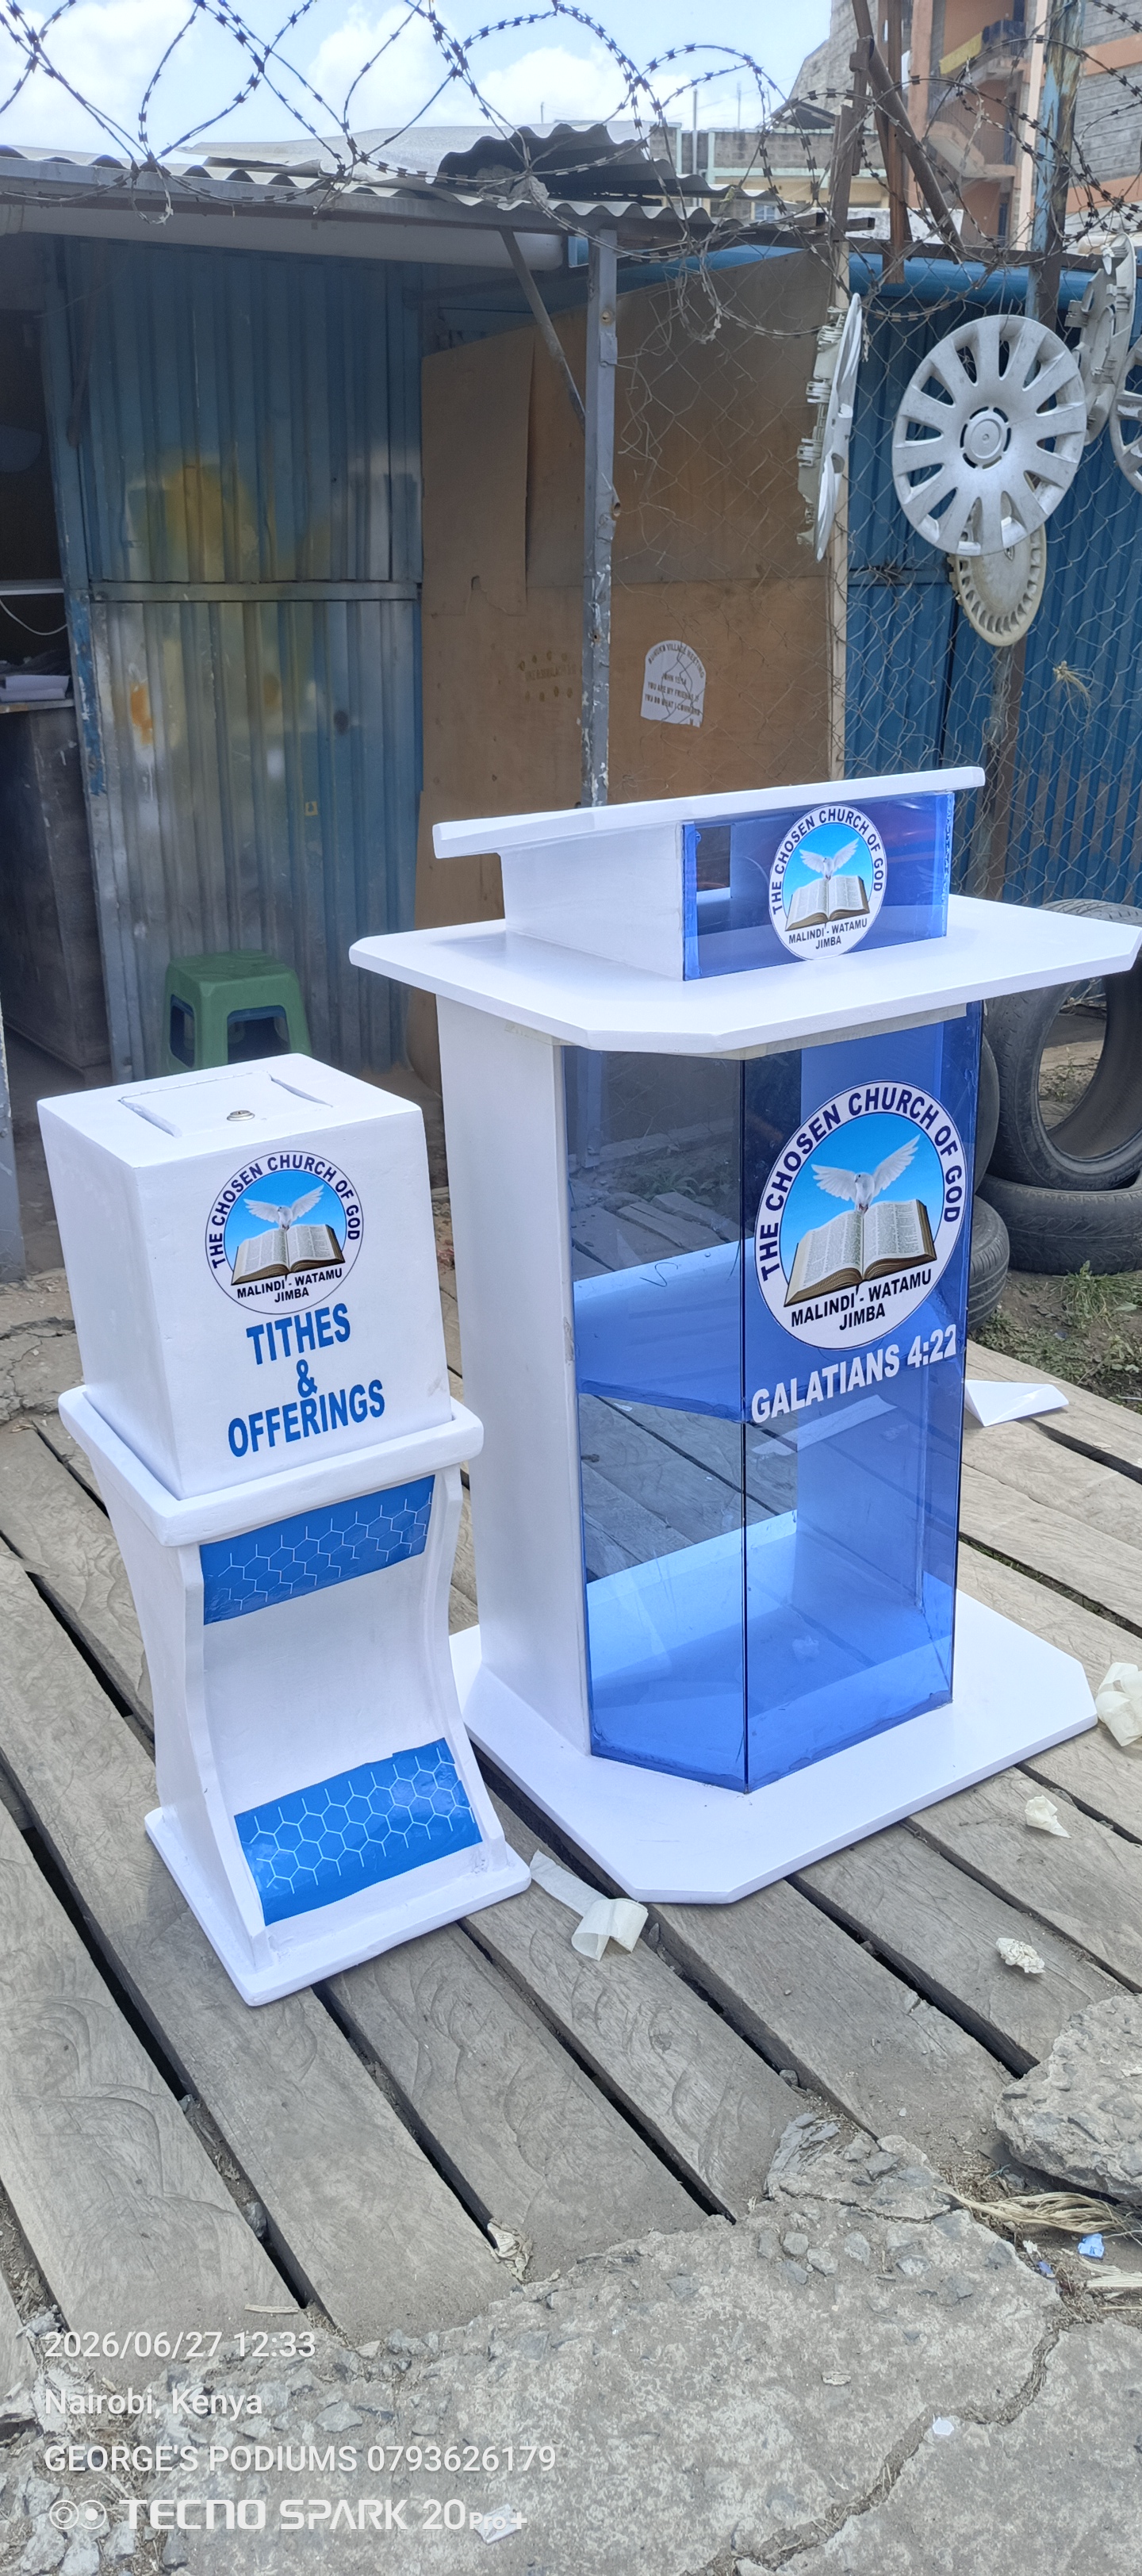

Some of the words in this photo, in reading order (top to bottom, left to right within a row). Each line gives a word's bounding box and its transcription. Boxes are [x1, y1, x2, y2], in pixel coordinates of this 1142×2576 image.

[818, 808, 870, 836] CHURCH
[775, 815, 815, 875] CHOSEN
[867, 834, 881, 853] OF
[873, 857, 883, 892] GOD
[771, 881, 783, 914] THE
[788, 927, 825, 945] MALINDI
[831, 918, 868, 935] WATAMU
[815, 937, 841, 950] JIMBA
[848, 1087, 940, 1131] CHURCH
[765, 1103, 841, 1213] CHOSEN
[933, 1125, 959, 1157] OF
[267, 1154, 337, 1183] CHURCH
[211, 1163, 263, 1227] CHOSEN
[335, 1179, 354, 1200] OF
[944, 1164, 964, 1224] GOD
[346, 1204, 361, 1240] GOD
[209, 1232, 226, 1269] THE
[759, 1221, 780, 1282] THE
[237, 1279, 285, 1299] MALINDI
[294, 1267, 343, 1287] WATAMU
[274, 1286, 310, 1303] JIMBA
[791, 1296, 856, 1328] MALINDI
[868, 1268, 933, 1303] WATAMU
[246, 1302, 351, 1365] TITHES
[839, 1301, 886, 1332] JIMBA
[296, 1359, 318, 1398] &
[751, 1344, 901, 1424] GALATIANS
[907, 1323, 956, 1368] 4:22
[228, 1378, 385, 1458] OFFERINGS
